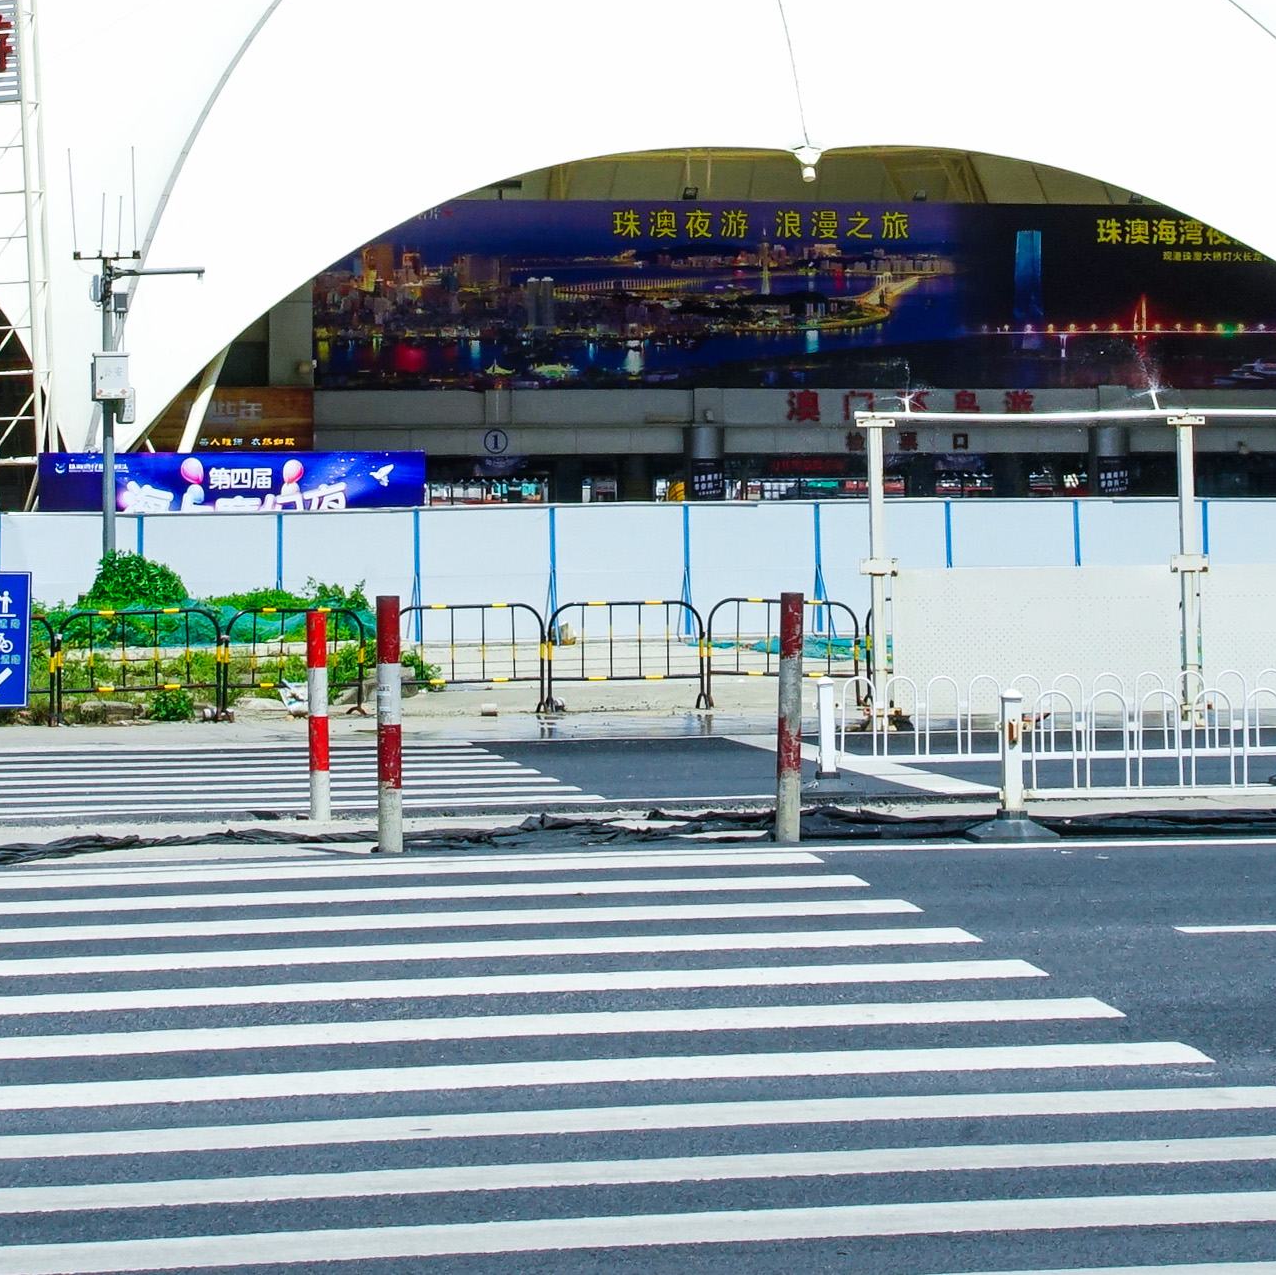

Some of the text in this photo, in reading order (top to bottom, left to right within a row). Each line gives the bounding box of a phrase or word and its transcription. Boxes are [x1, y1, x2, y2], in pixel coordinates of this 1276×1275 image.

[612, 209, 910, 240] 珠澳夜游 浪漫之旅
[1096, 218, 1240, 245] 珠澳海湾夜
[846, 432, 969, 451] 检票口
[209, 467, 272, 490] 第四届
